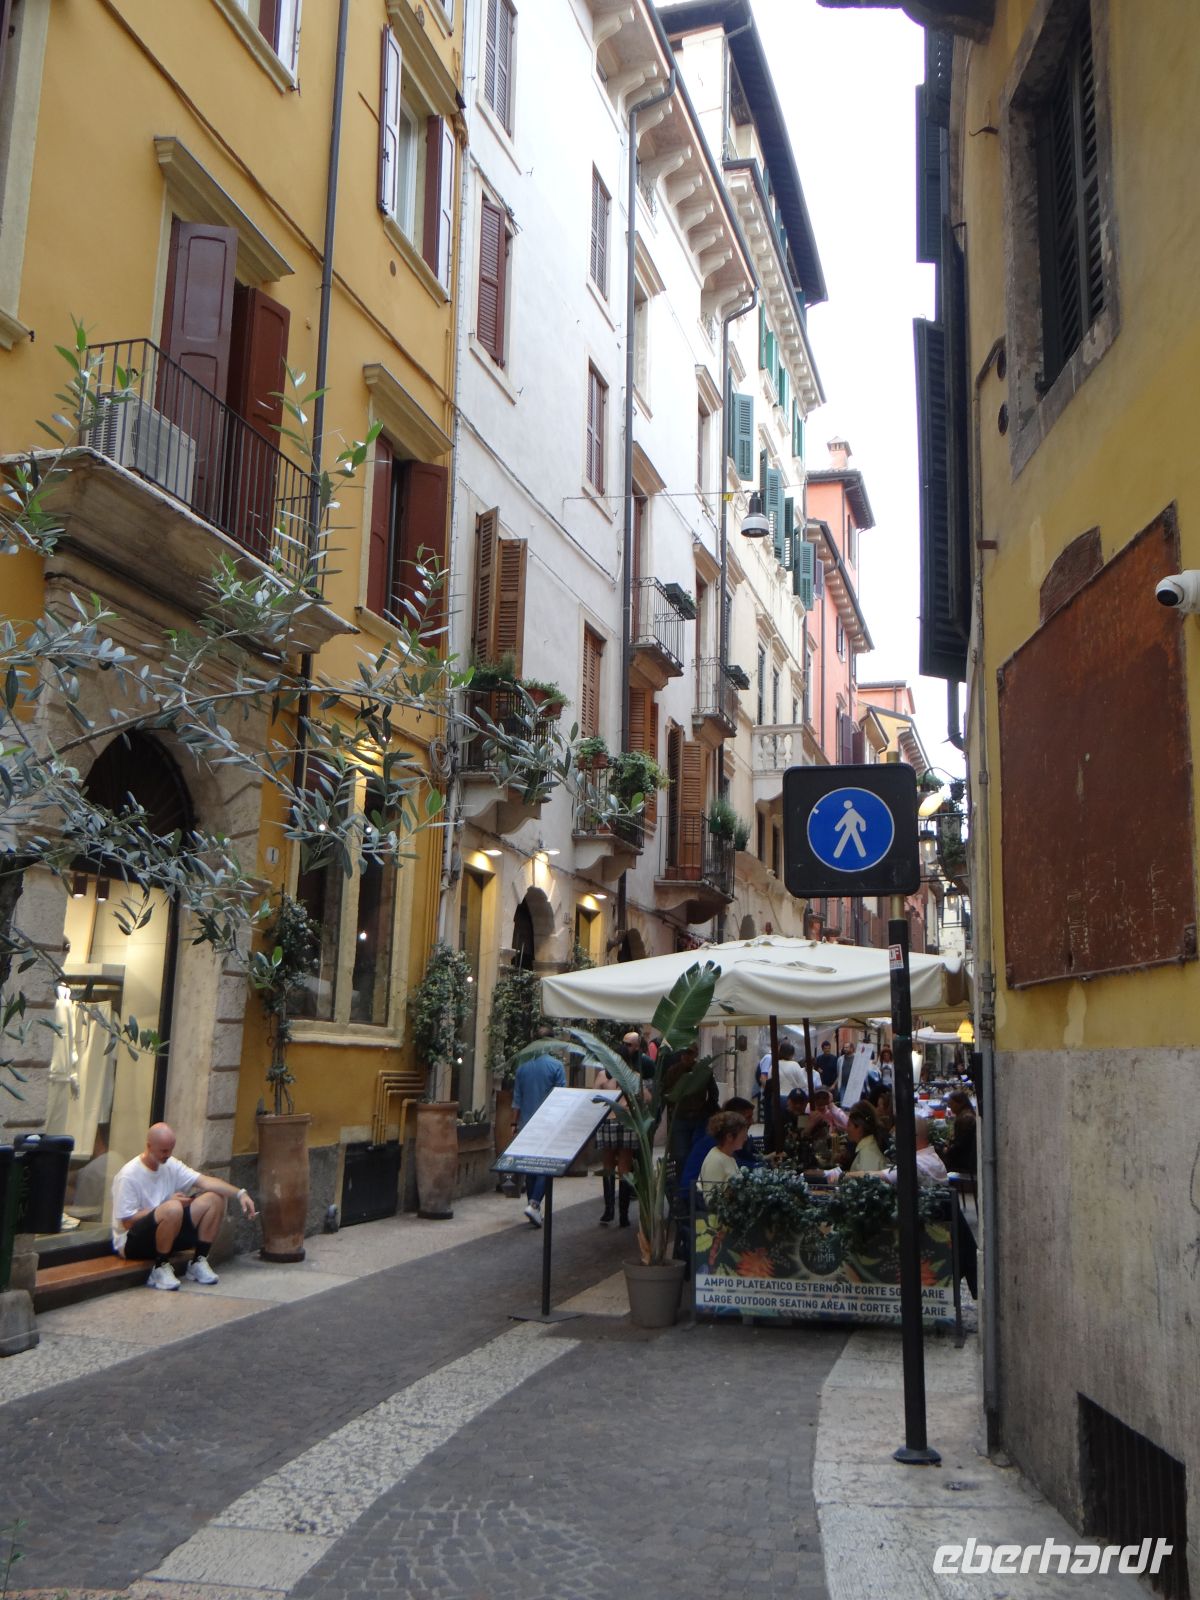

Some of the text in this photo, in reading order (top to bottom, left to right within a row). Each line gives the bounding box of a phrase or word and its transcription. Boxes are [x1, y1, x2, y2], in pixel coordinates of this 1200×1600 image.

[703, 1277, 733, 1288] AMPIO
[736, 1278, 793, 1291] PLATEATICO
[842, 1284, 852, 1294] IN
[855, 1285, 887, 1296] CORTE
[703, 1293, 733, 1304] LARGE
[734, 1295, 777, 1307] OUTDOOR
[779, 1298, 818, 1309] SEATING
[820, 1300, 846, 1311] AREA
[848, 1302, 858, 1312] IN
[860, 1302, 891, 1314] CORTE
